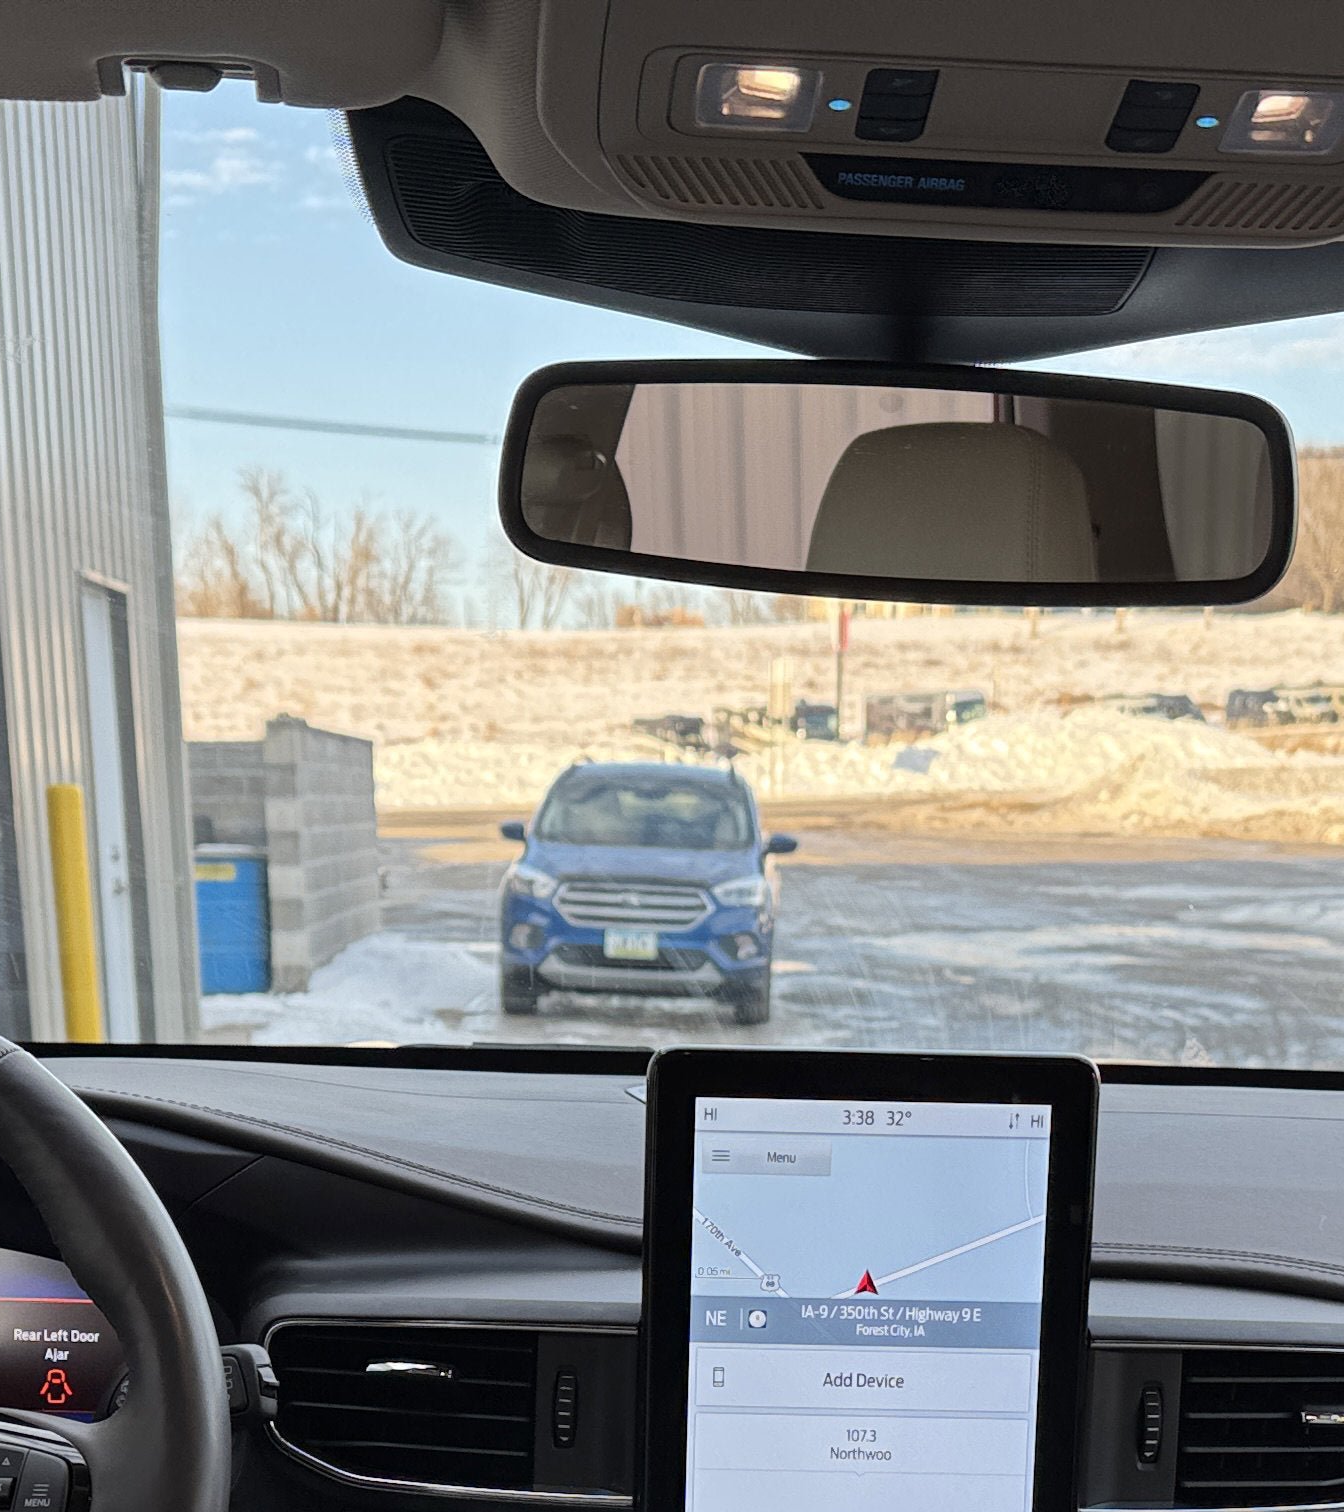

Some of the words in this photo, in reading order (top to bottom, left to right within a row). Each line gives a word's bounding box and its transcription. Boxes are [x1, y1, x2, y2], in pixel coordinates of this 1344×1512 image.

[837, 171, 913, 190] PASSENGER
[917, 174, 965, 192] AIRBAG
[703, 1108, 718, 1122] HI
[842, 1110, 875, 1127] 3:38
[1030, 1114, 1045, 1129] HI
[766, 1151, 797, 1164] Menu
[701, 1217, 725, 1243] 170th
[724, 1239, 742, 1257] Ave
[705, 1310, 728, 1327] NE
[801, 1306, 827, 1320] IA-9
[839, 1306, 879, 1321] 350th
[880, 1307, 895, 1321] St
[905, 1308, 960, 1326] Highway
[961, 1309, 971, 1322] 9
[972, 1309, 982, 1322] E
[13, 1329, 42, 1343] Rear
[43, 1329, 68, 1343] Left
[70, 1330, 100, 1344] Door
[856, 1324, 890, 1337] Forest
[913, 1325, 926, 1338] IA
[44, 1348, 70, 1363] Ajar
[823, 1372, 853, 1388] Add
[856, 1373, 905, 1390] Device
[846, 1428, 877, 1443] 107.3
[829, 1446, 892, 1462] Northwoo
[23, 1498, 51, 1507] MENU
